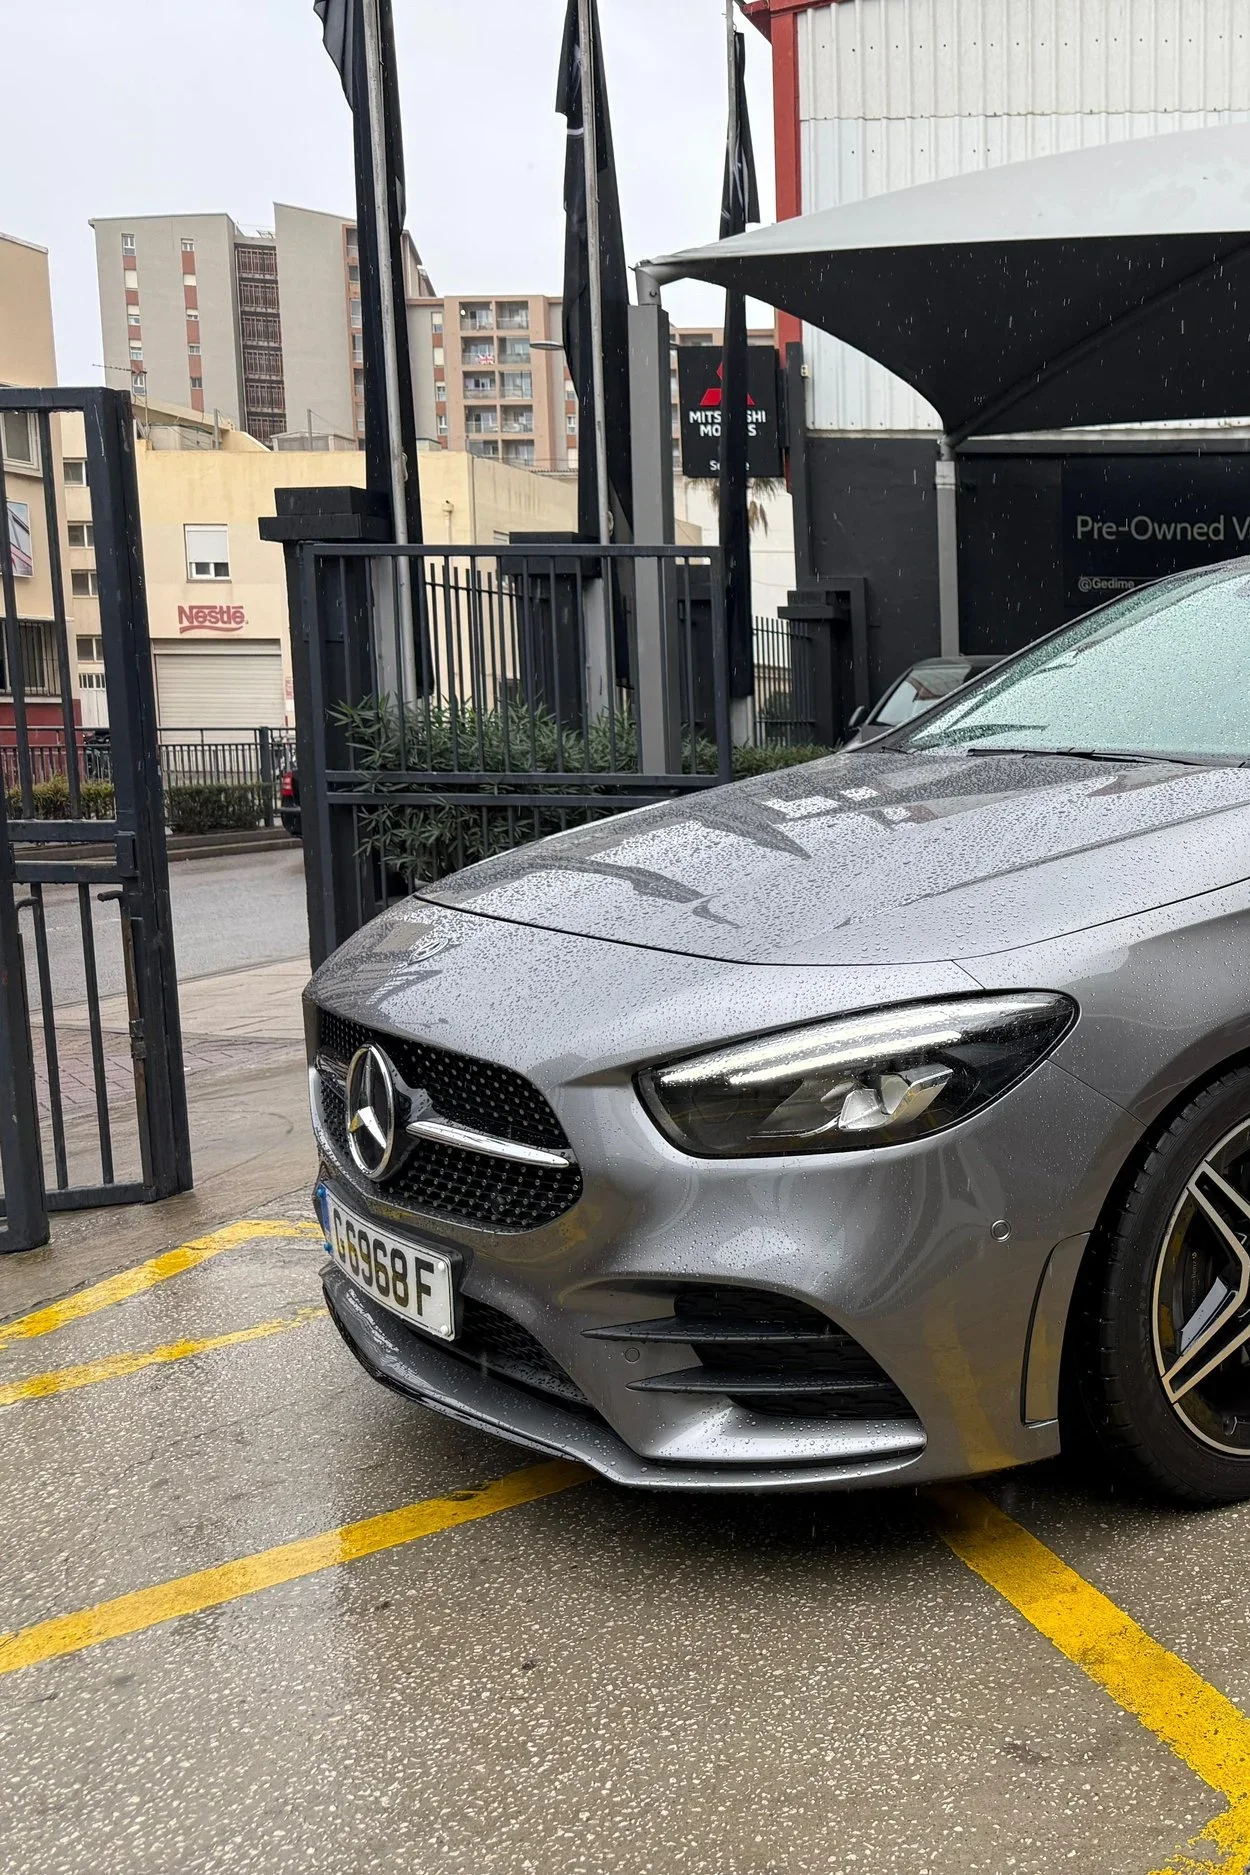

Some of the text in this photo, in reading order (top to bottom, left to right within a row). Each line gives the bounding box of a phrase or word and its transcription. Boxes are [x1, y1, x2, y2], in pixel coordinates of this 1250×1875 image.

[688, 410, 767, 424] MITSSHI
[699, 424, 758, 437] MOS
[1076, 514, 1225, 541] Pre-Owned
